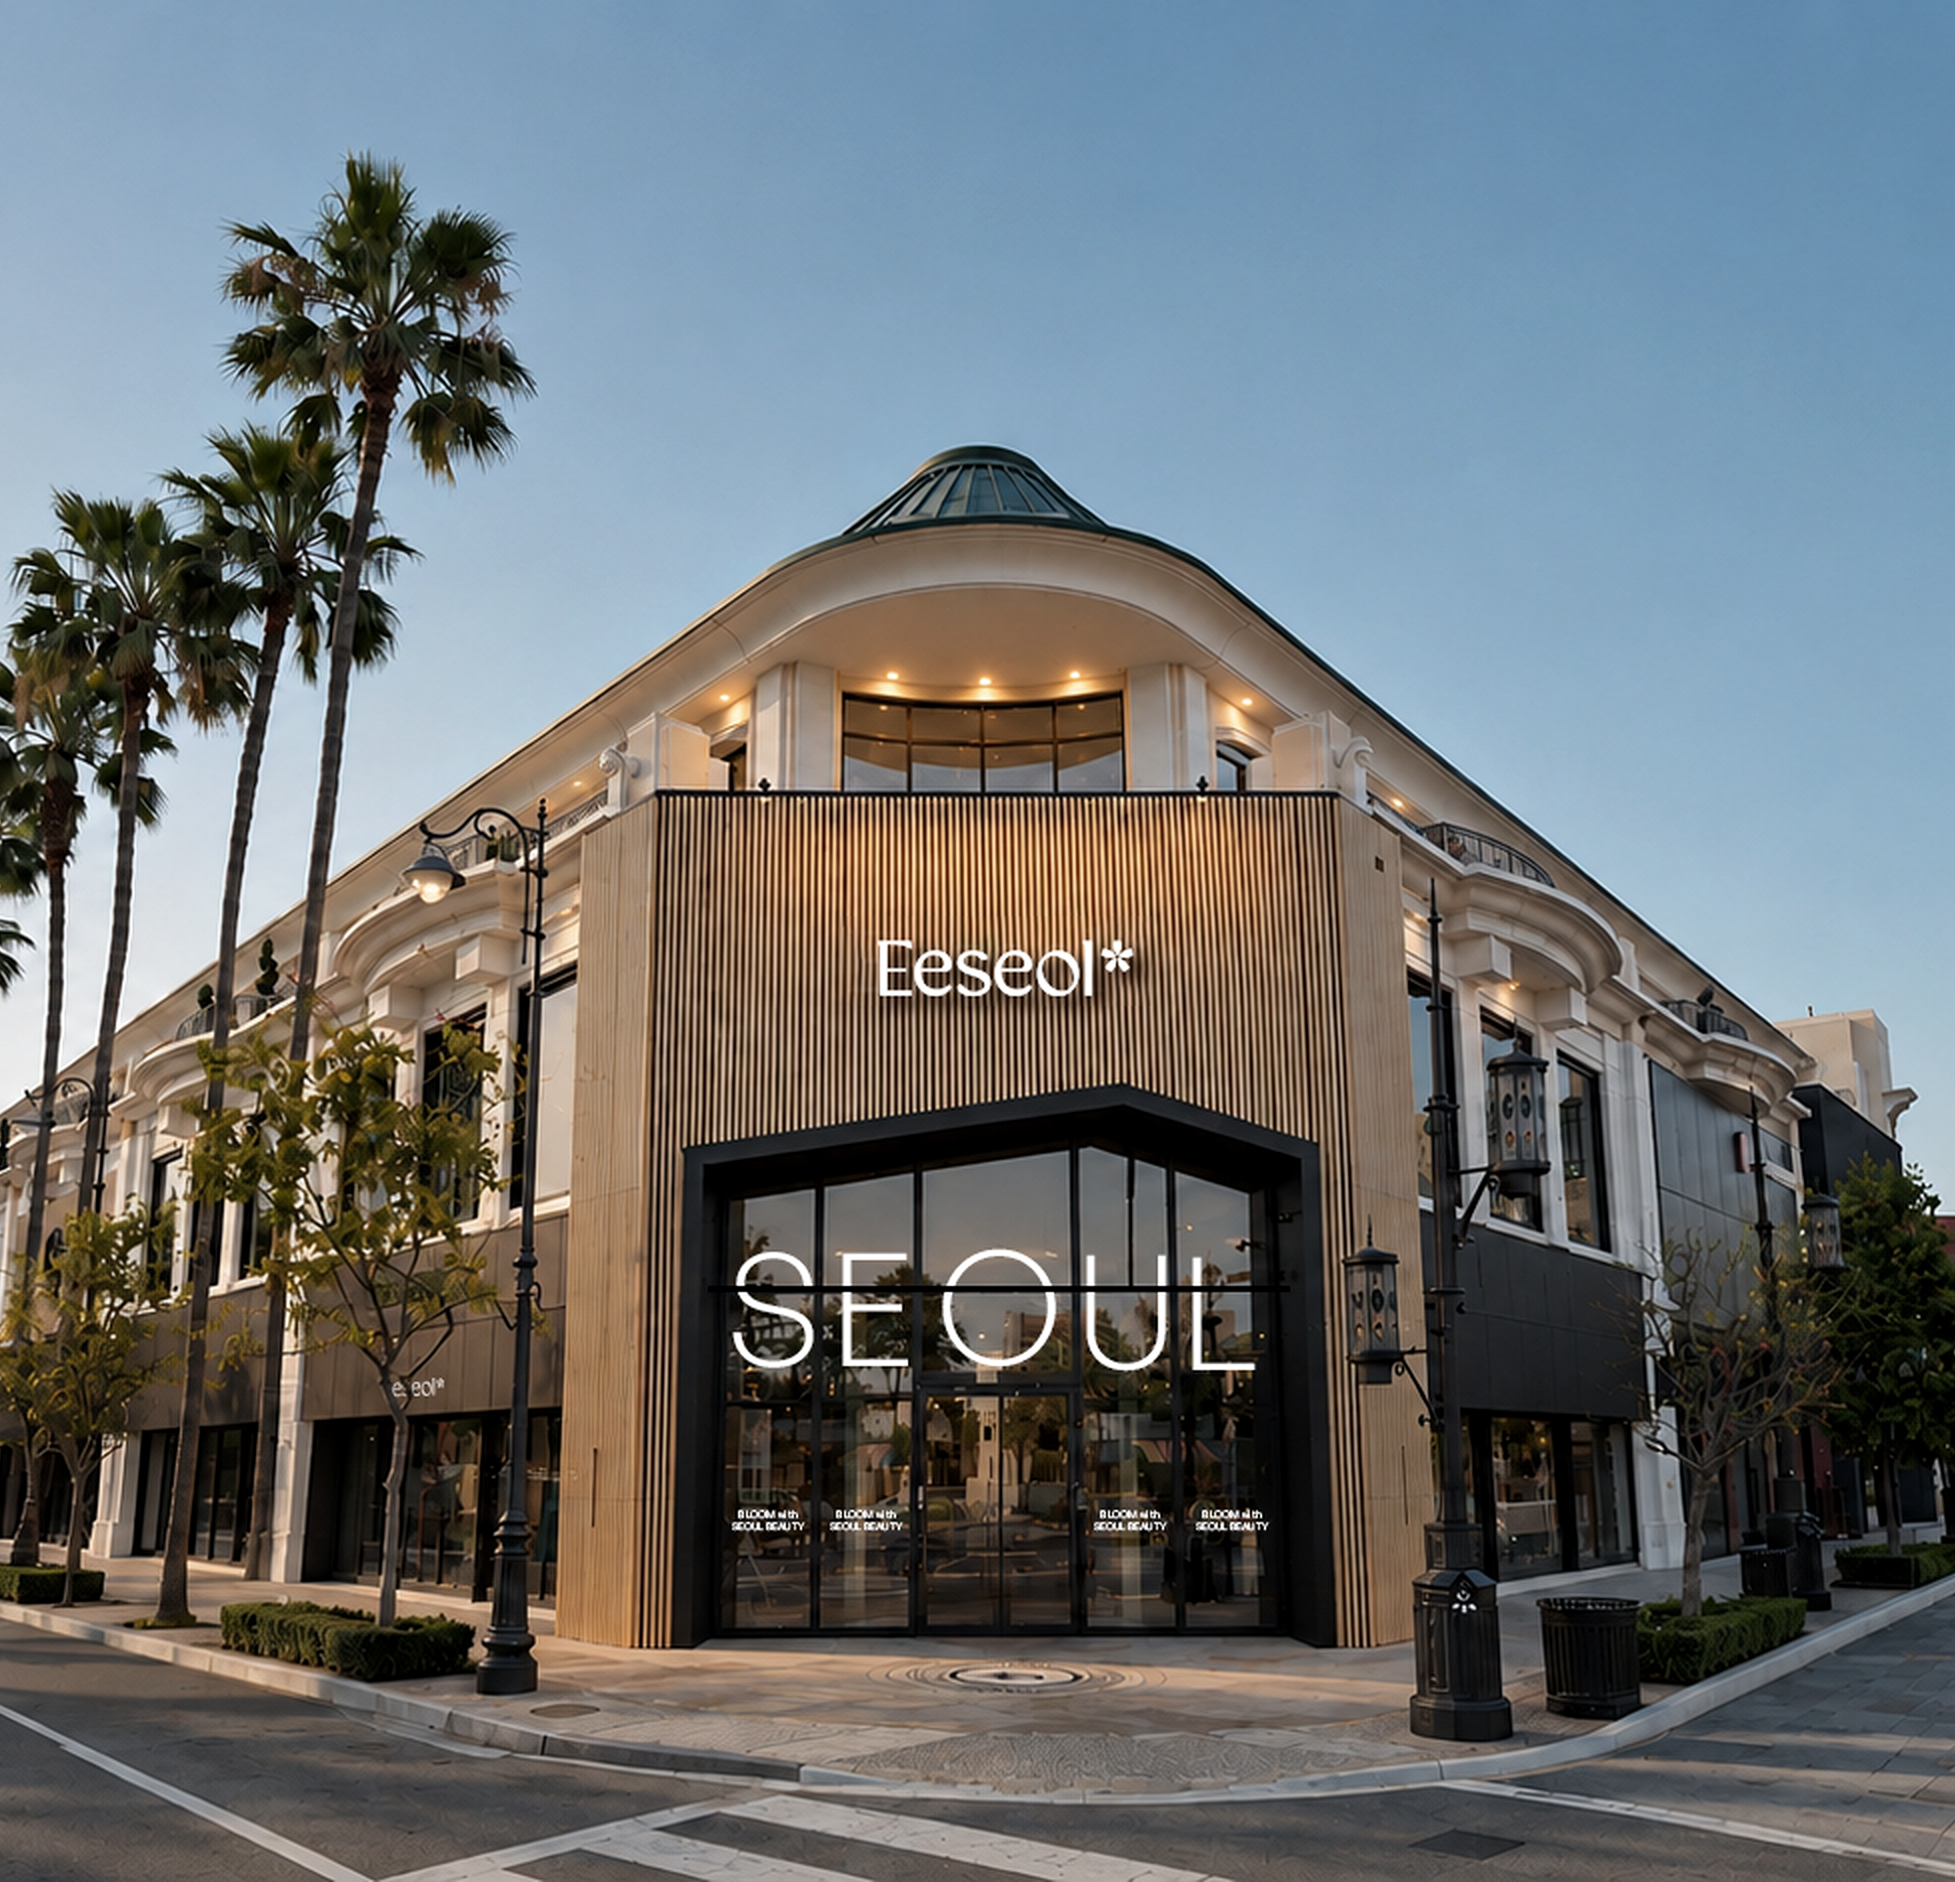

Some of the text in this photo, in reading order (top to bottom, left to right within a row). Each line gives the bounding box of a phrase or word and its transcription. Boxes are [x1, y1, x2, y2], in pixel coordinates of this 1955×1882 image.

[733, 1249, 1256, 1371] SEOUL
[737, 1509, 776, 1519] BLOOM
[835, 1509, 874, 1519] BLOOM
[1099, 1509, 1138, 1519] BLOOM
[1201, 1509, 1240, 1519] BLOOM
[731, 1521, 805, 1531] SEOUL BEAUTY
[829, 1521, 903, 1531] SEOUL BEAUTY
[1093, 1521, 1167, 1531] SEOUL BEAUTY
[1195, 1521, 1269, 1531] SEOUL BEAUTY
